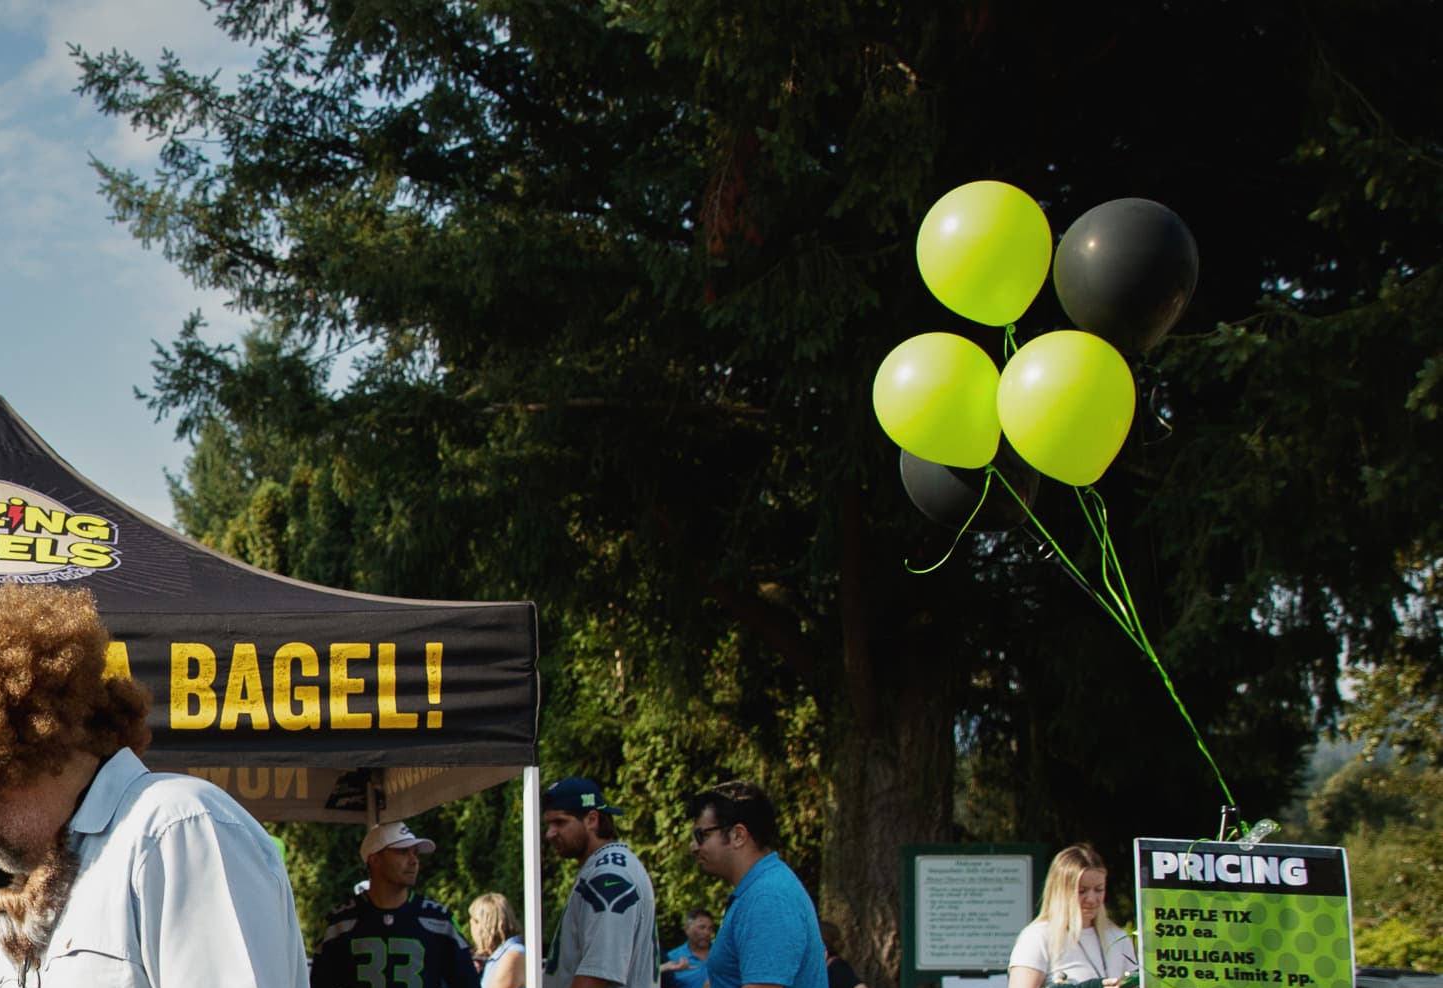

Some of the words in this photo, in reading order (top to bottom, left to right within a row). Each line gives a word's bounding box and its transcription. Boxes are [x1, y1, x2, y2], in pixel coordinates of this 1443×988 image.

[170, 641, 443, 730] BAGEL!
[1152, 851, 1308, 886] PRICING
[1155, 907, 1217, 922] RAFFLE
[1223, 910, 1252, 923] TIX
[1155, 924, 1187, 938] $20
[1193, 927, 1217, 939] ea.
[1156, 949, 1255, 964] MULLIGANS
[1157, 965, 1188, 979] $20
[1195, 969, 1219, 982] ea,
[1224, 968, 1268, 982] Limit
[1273, 970, 1283, 983] 2
[1288, 973, 1315, 987] pp.
